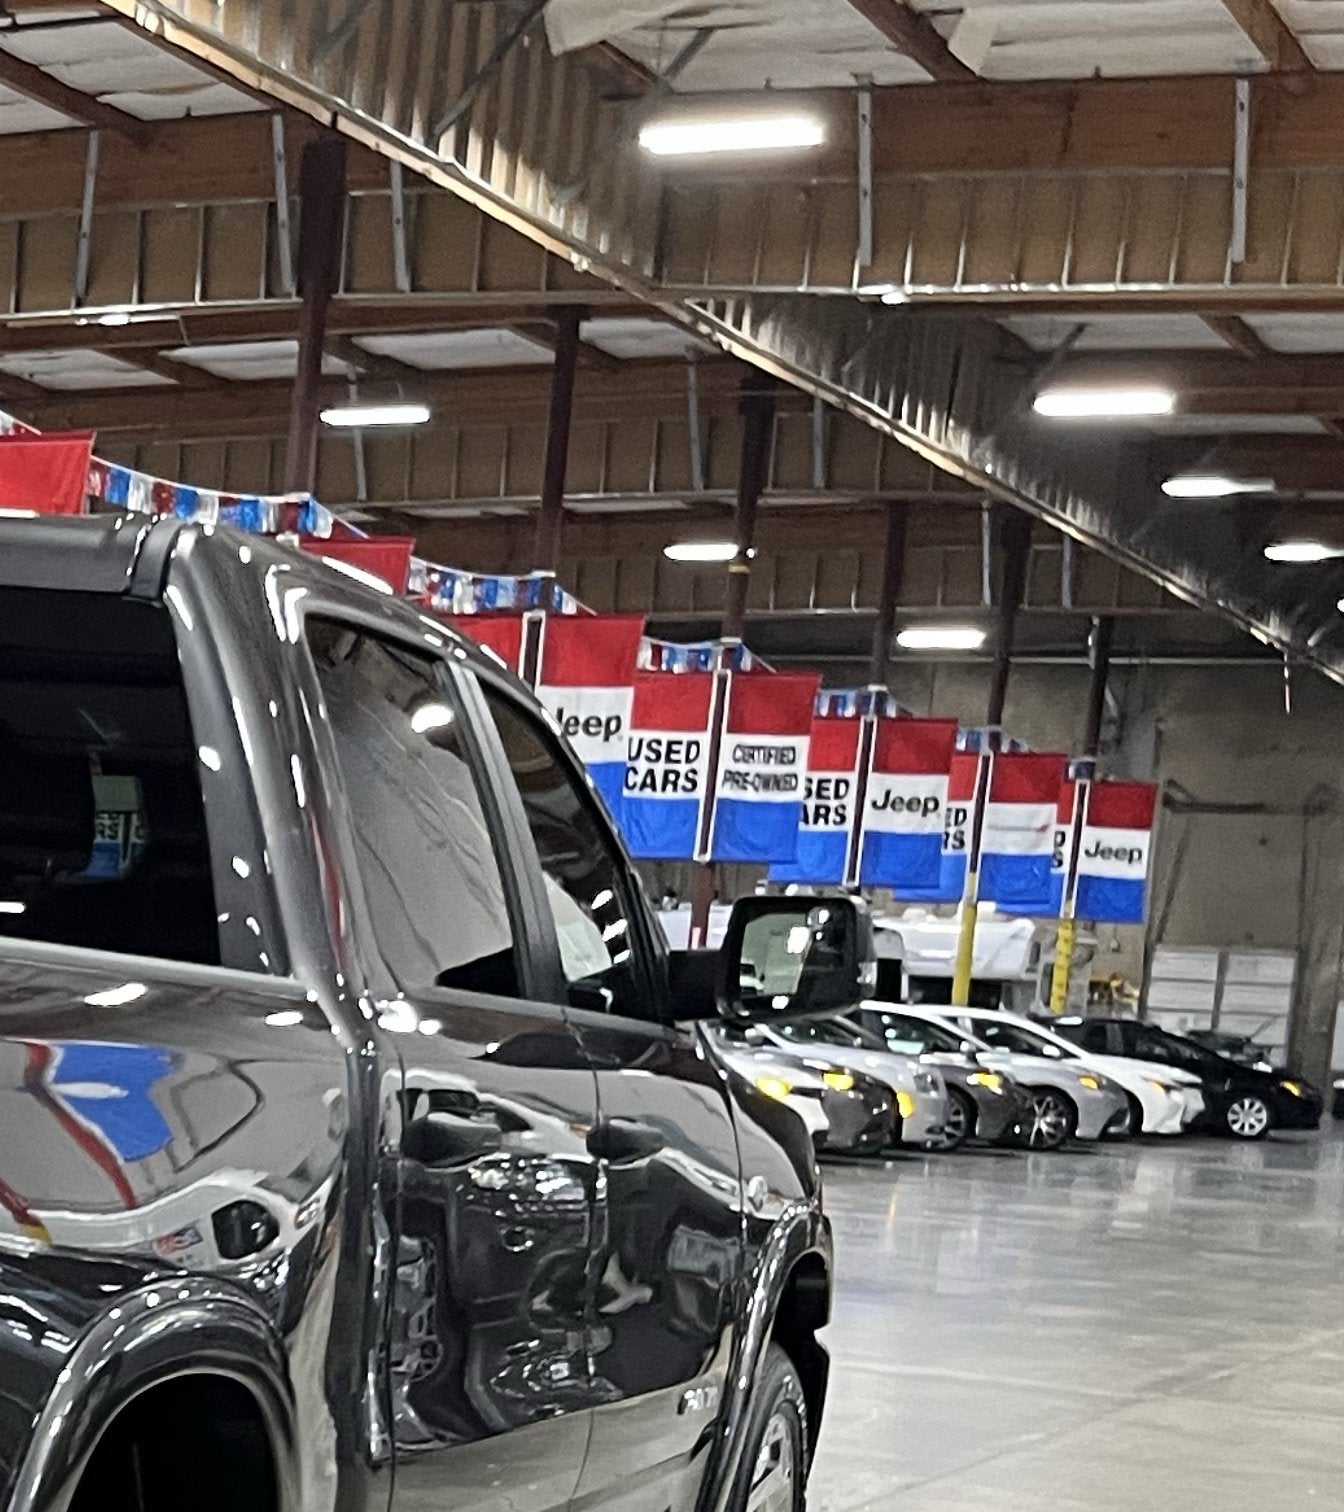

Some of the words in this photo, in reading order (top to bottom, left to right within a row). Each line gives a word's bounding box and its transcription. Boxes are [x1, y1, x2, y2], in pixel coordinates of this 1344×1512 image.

[627, 736, 702, 765] USED
[624, 766, 699, 793] CARS
[870, 788, 940, 817] Jeep
[1083, 839, 1143, 864] Jeep
